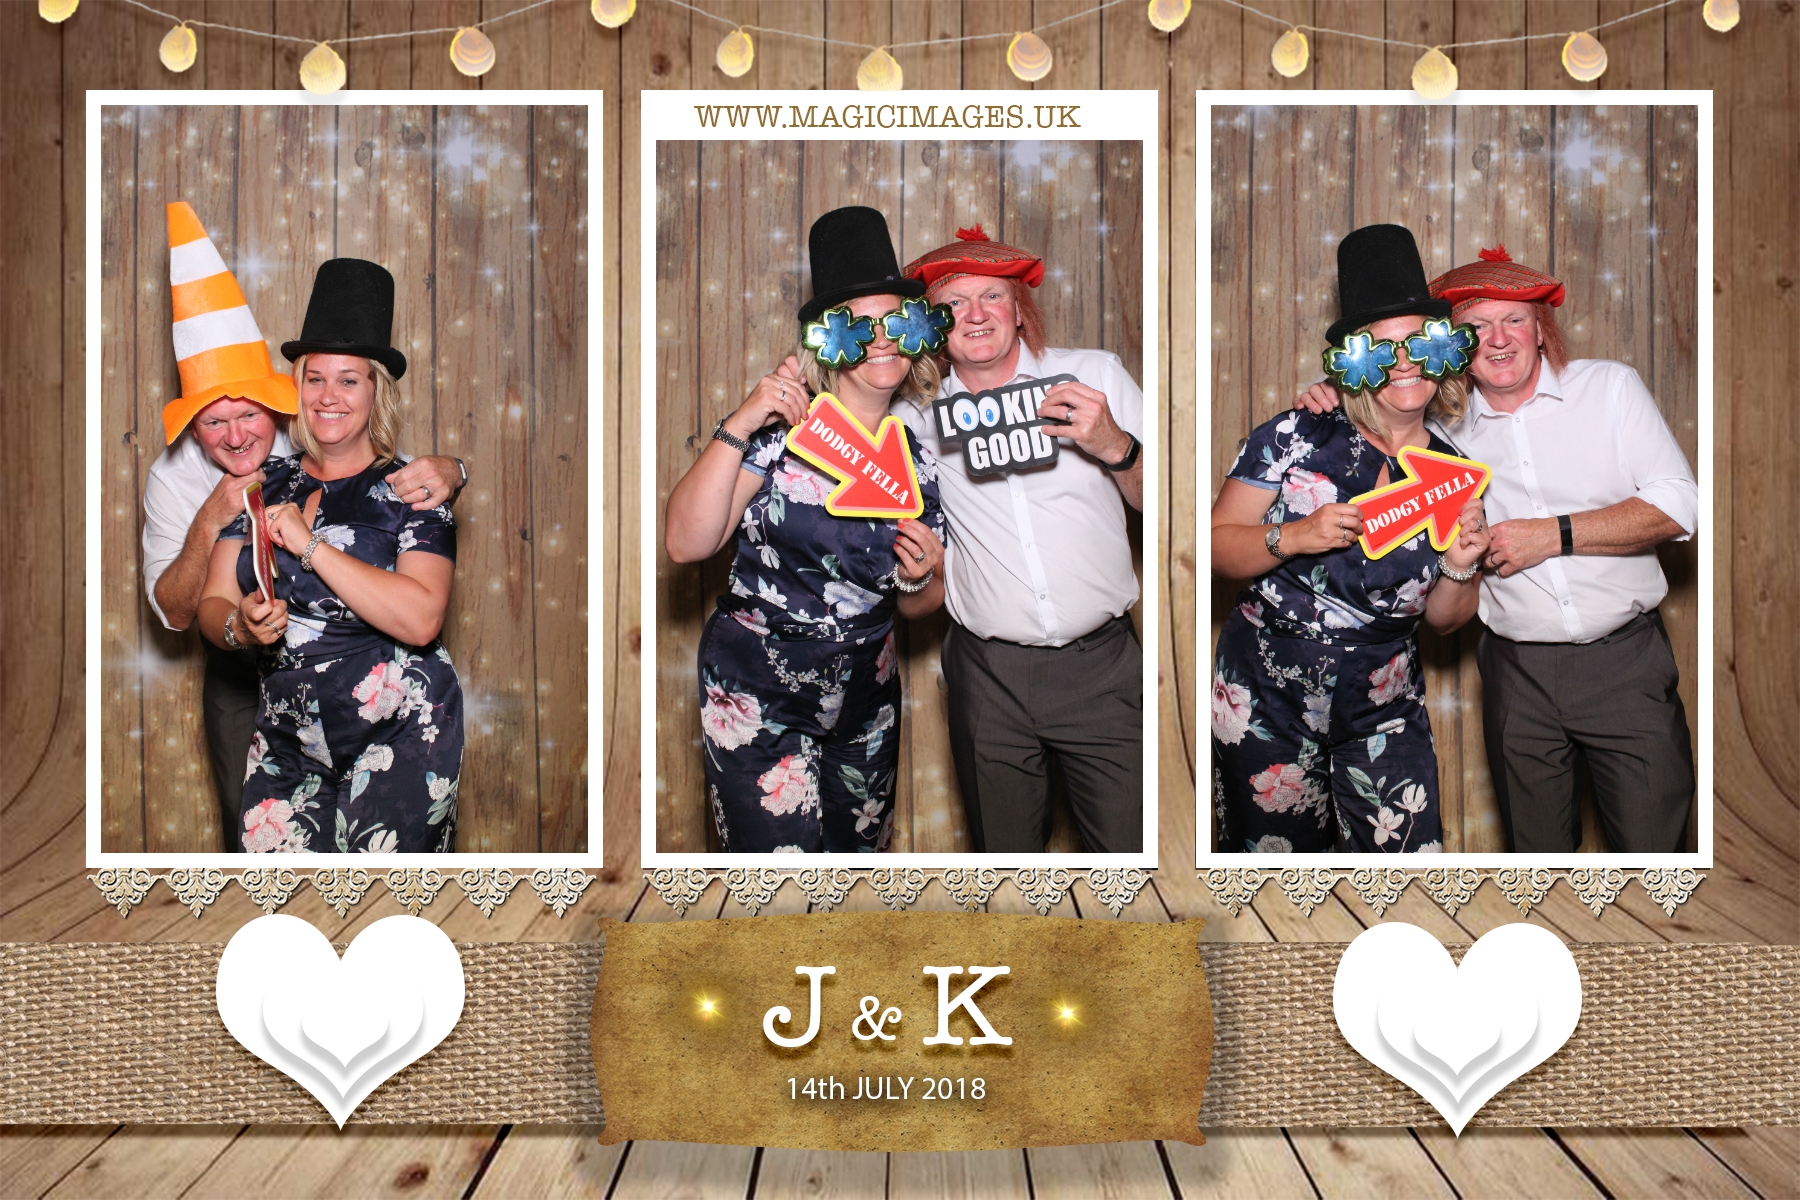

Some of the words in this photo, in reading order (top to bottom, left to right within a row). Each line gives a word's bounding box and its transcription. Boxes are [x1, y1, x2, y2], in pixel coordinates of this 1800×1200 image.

[939, 381, 1070, 437] LOOKIN
[809, 417, 865, 466] DODGY
[861, 460, 909, 505] FELLA
[968, 425, 1053, 470] GOOD
[1365, 496, 1422, 535] DODGY
[1423, 471, 1476, 506] FELLA
